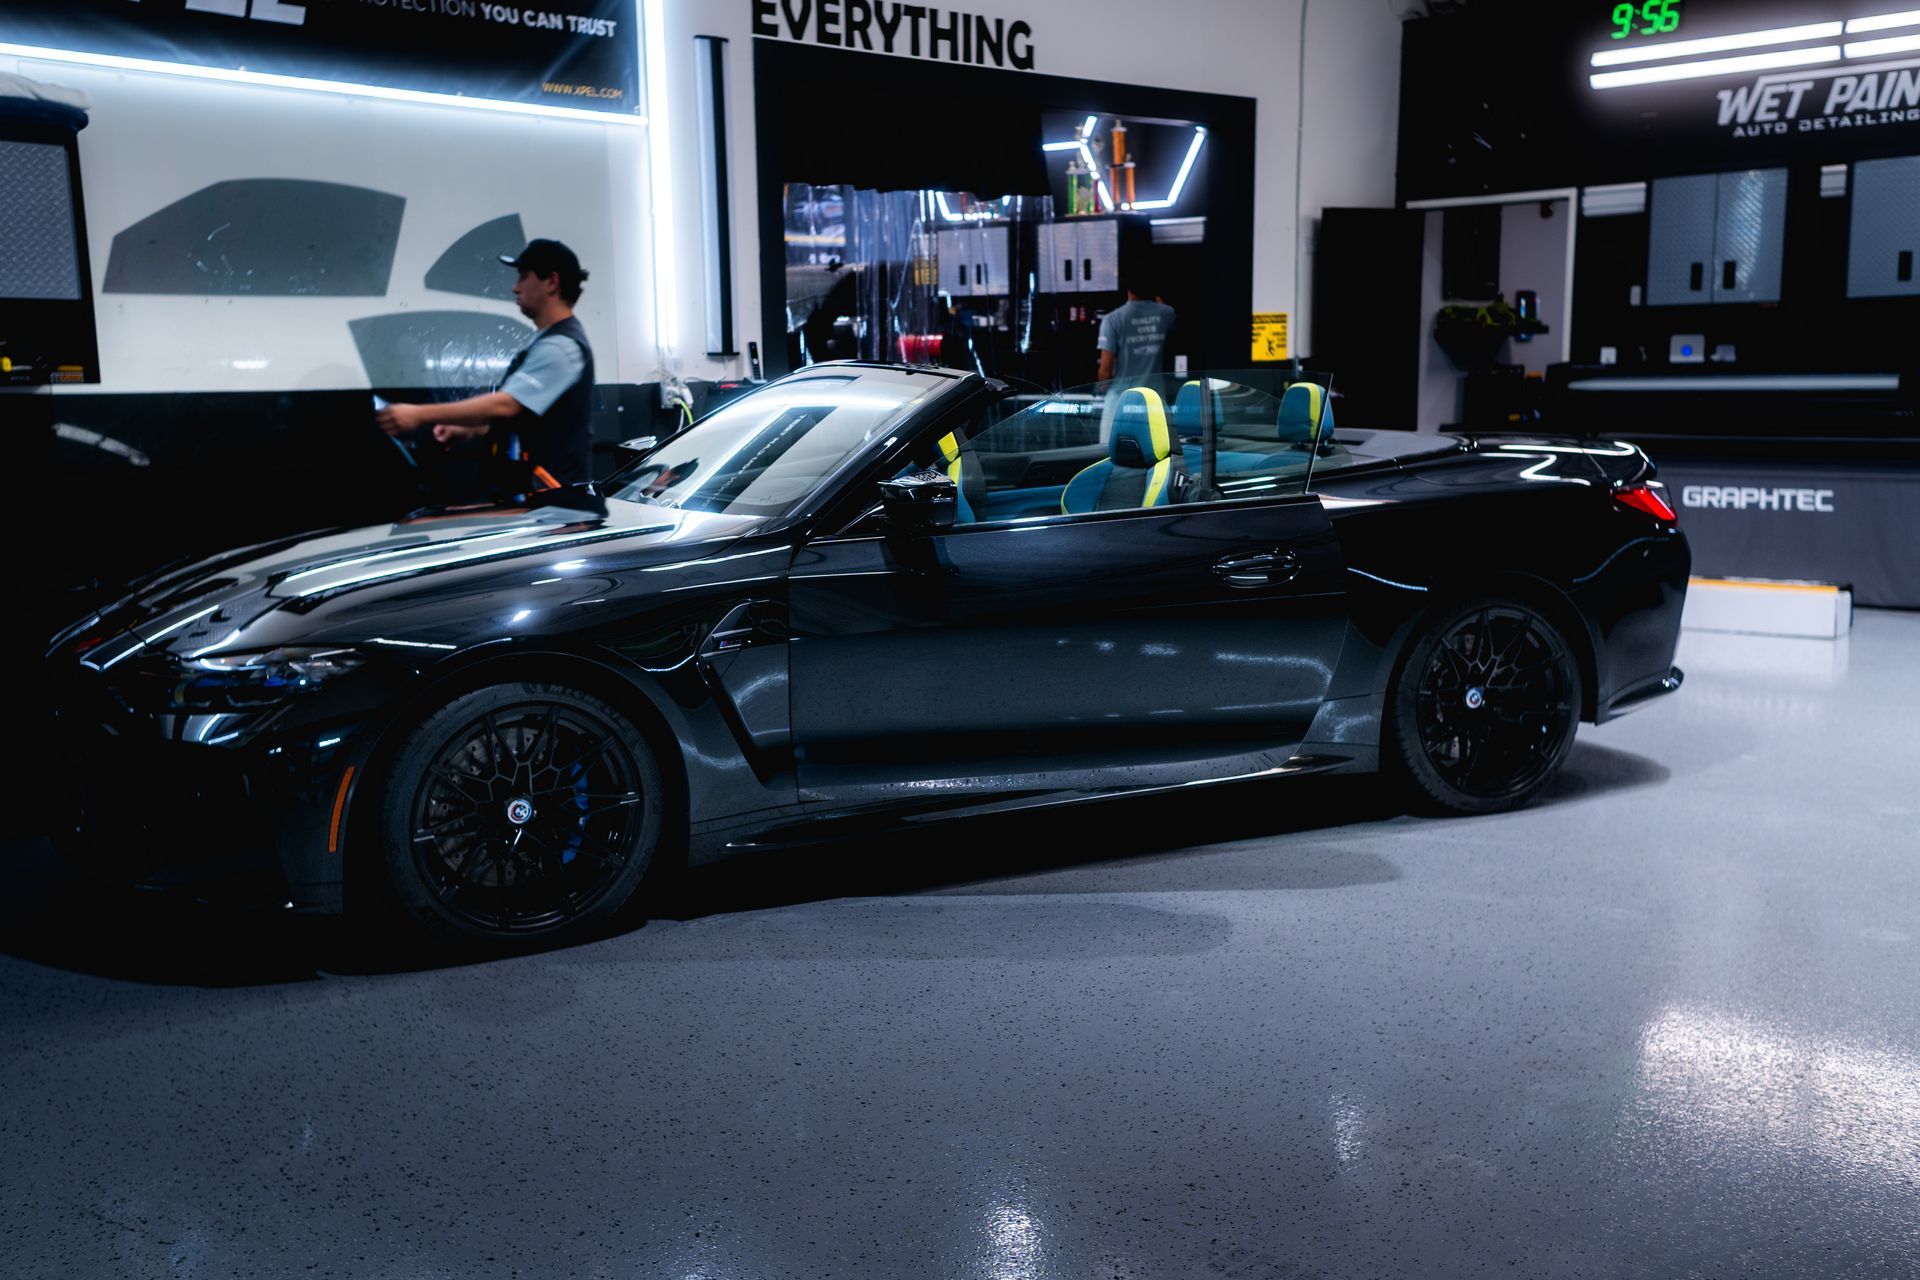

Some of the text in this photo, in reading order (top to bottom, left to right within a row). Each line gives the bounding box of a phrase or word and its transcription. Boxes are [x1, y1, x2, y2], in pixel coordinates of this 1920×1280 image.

[359, 0, 617, 37] ECTION YOU CAN TRUST
[752, 0, 1035, 70] EVERYTHING
[1610, 0, 1681, 39] 9:56
[543, 81, 623, 100] WWW.XPEL.COM
[1717, 77, 1814, 125] WET
[1733, 109, 1920, 138] AUTO DETAILING
[1682, 485, 1834, 512] GRAPHTEC
